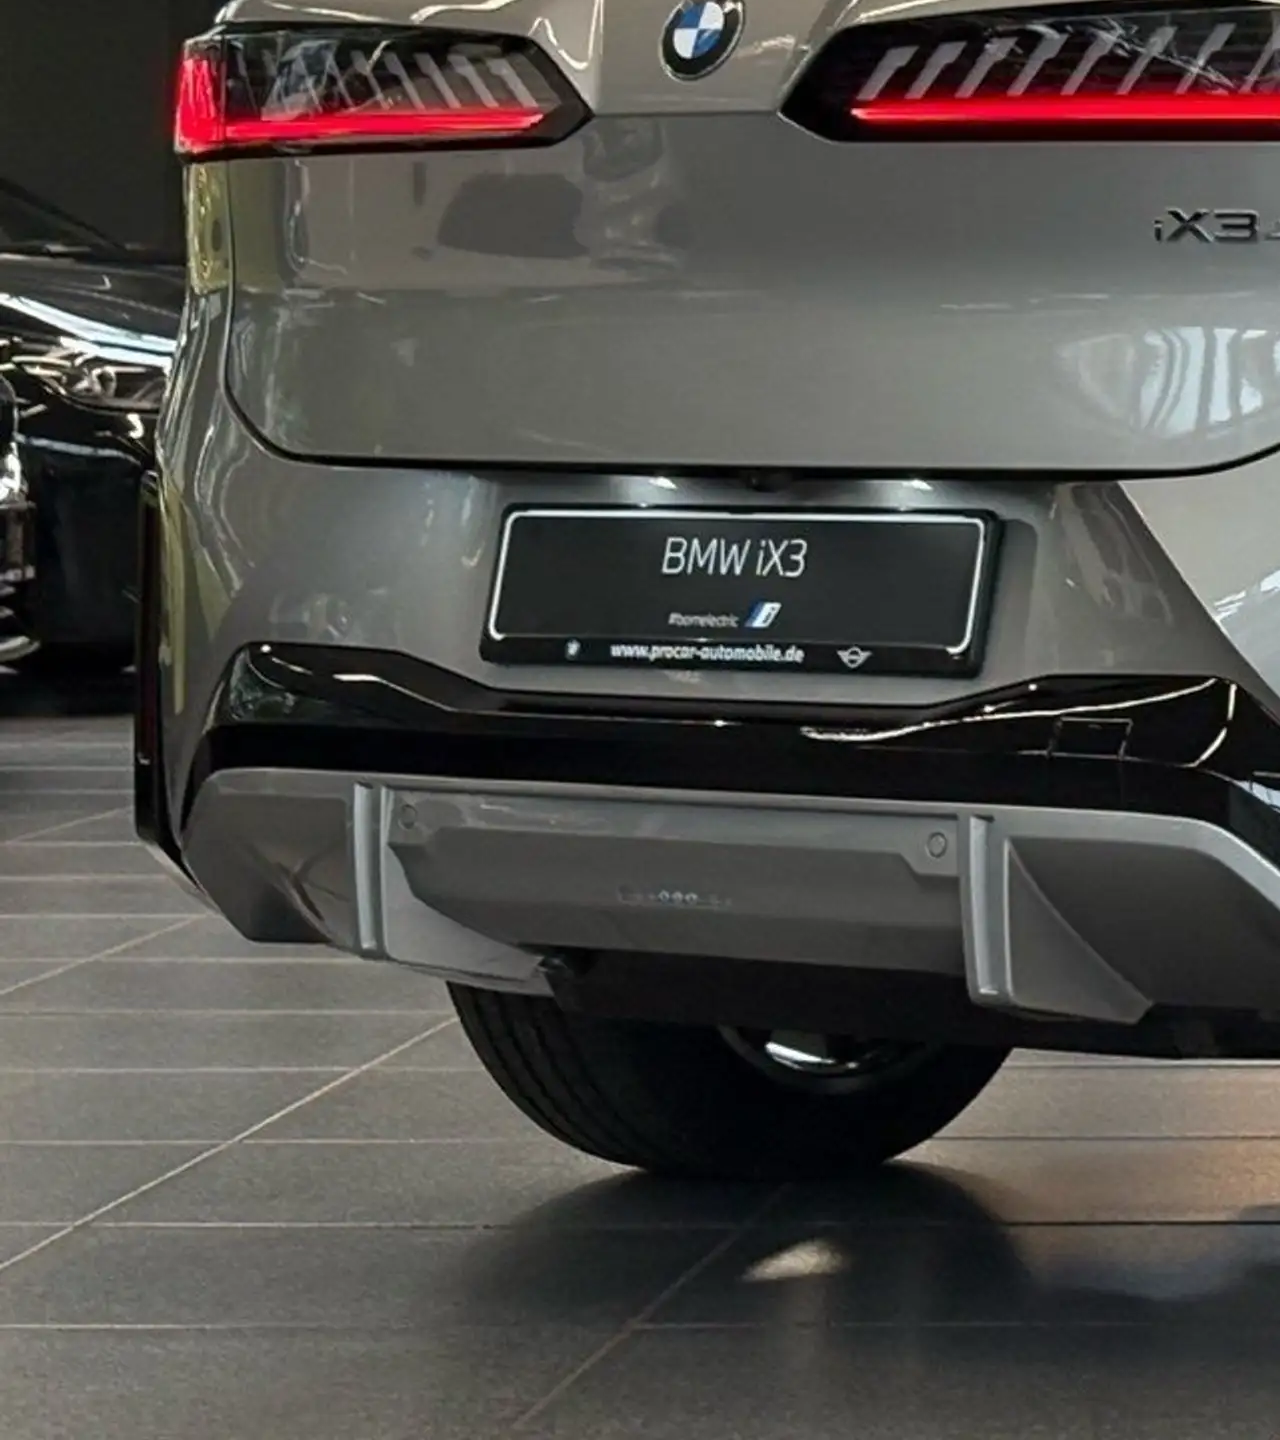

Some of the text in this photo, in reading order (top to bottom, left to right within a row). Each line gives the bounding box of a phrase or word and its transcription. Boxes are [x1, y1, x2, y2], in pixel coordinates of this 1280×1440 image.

[1152, 206, 1260, 244] iX3
[661, 536, 808, 578] BMW iX3
[609, 643, 805, 663] www.procar-automobile.de
